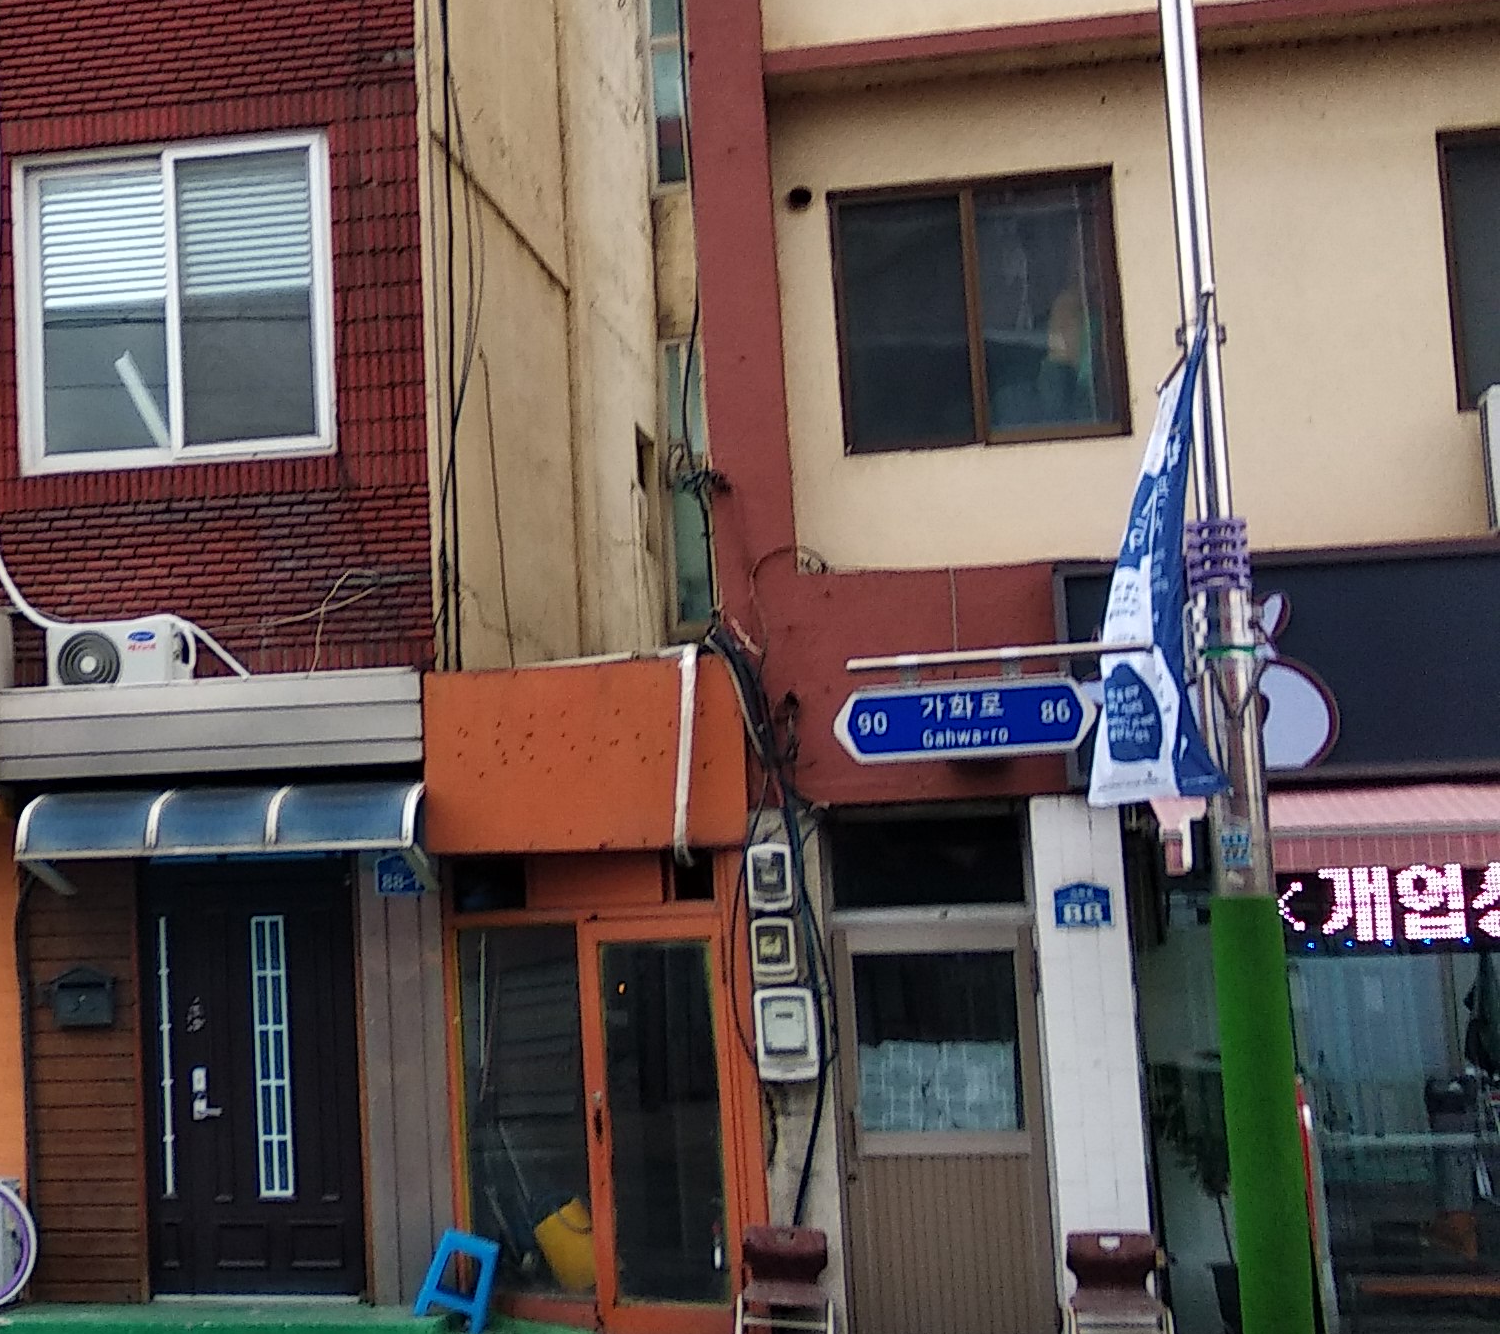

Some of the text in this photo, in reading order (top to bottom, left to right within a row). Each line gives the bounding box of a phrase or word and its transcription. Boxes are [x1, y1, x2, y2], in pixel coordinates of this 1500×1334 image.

[920, 692, 1004, 723] 가화로
[1040, 698, 1072, 725] 86
[857, 710, 888, 736] 90
[922, 727, 1009, 749] Gahwa-ro
